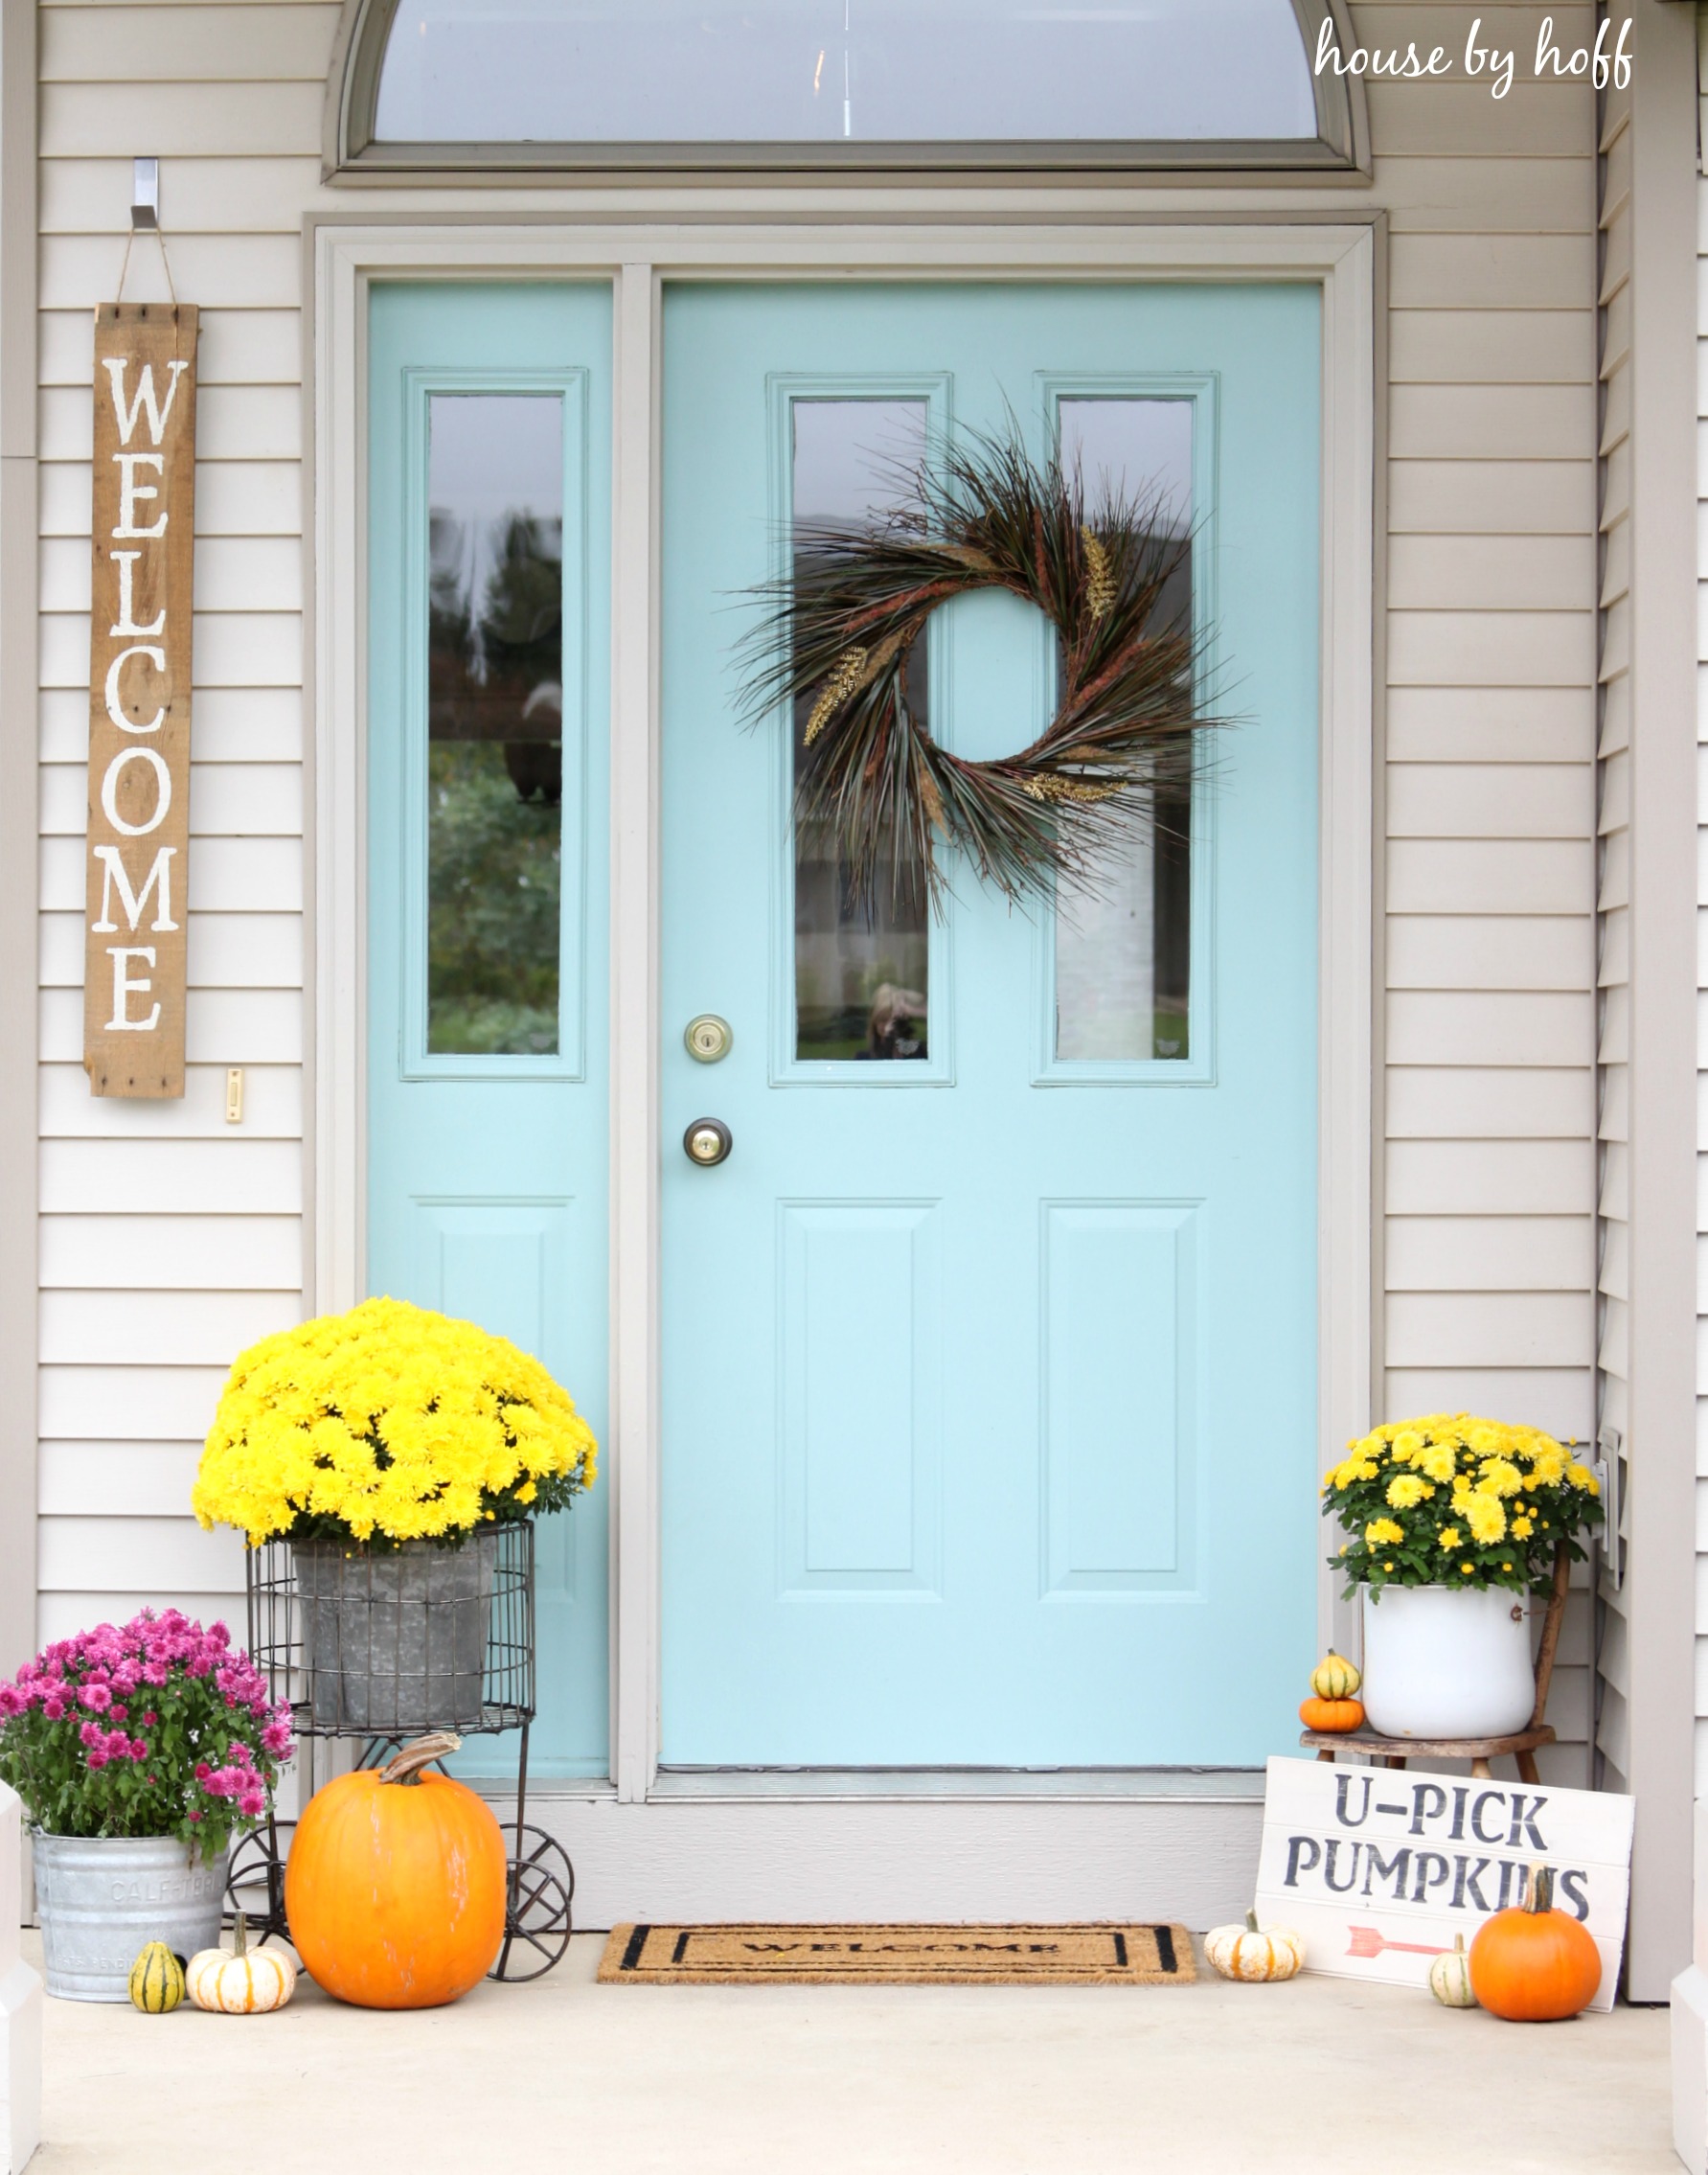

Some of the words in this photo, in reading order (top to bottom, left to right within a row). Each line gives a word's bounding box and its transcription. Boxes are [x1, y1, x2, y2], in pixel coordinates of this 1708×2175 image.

[91, 357, 189, 1030] WELCOME
[1334, 1774, 1548, 1850] U-PICK
[742, 1943, 1059, 1953] WELCOME
